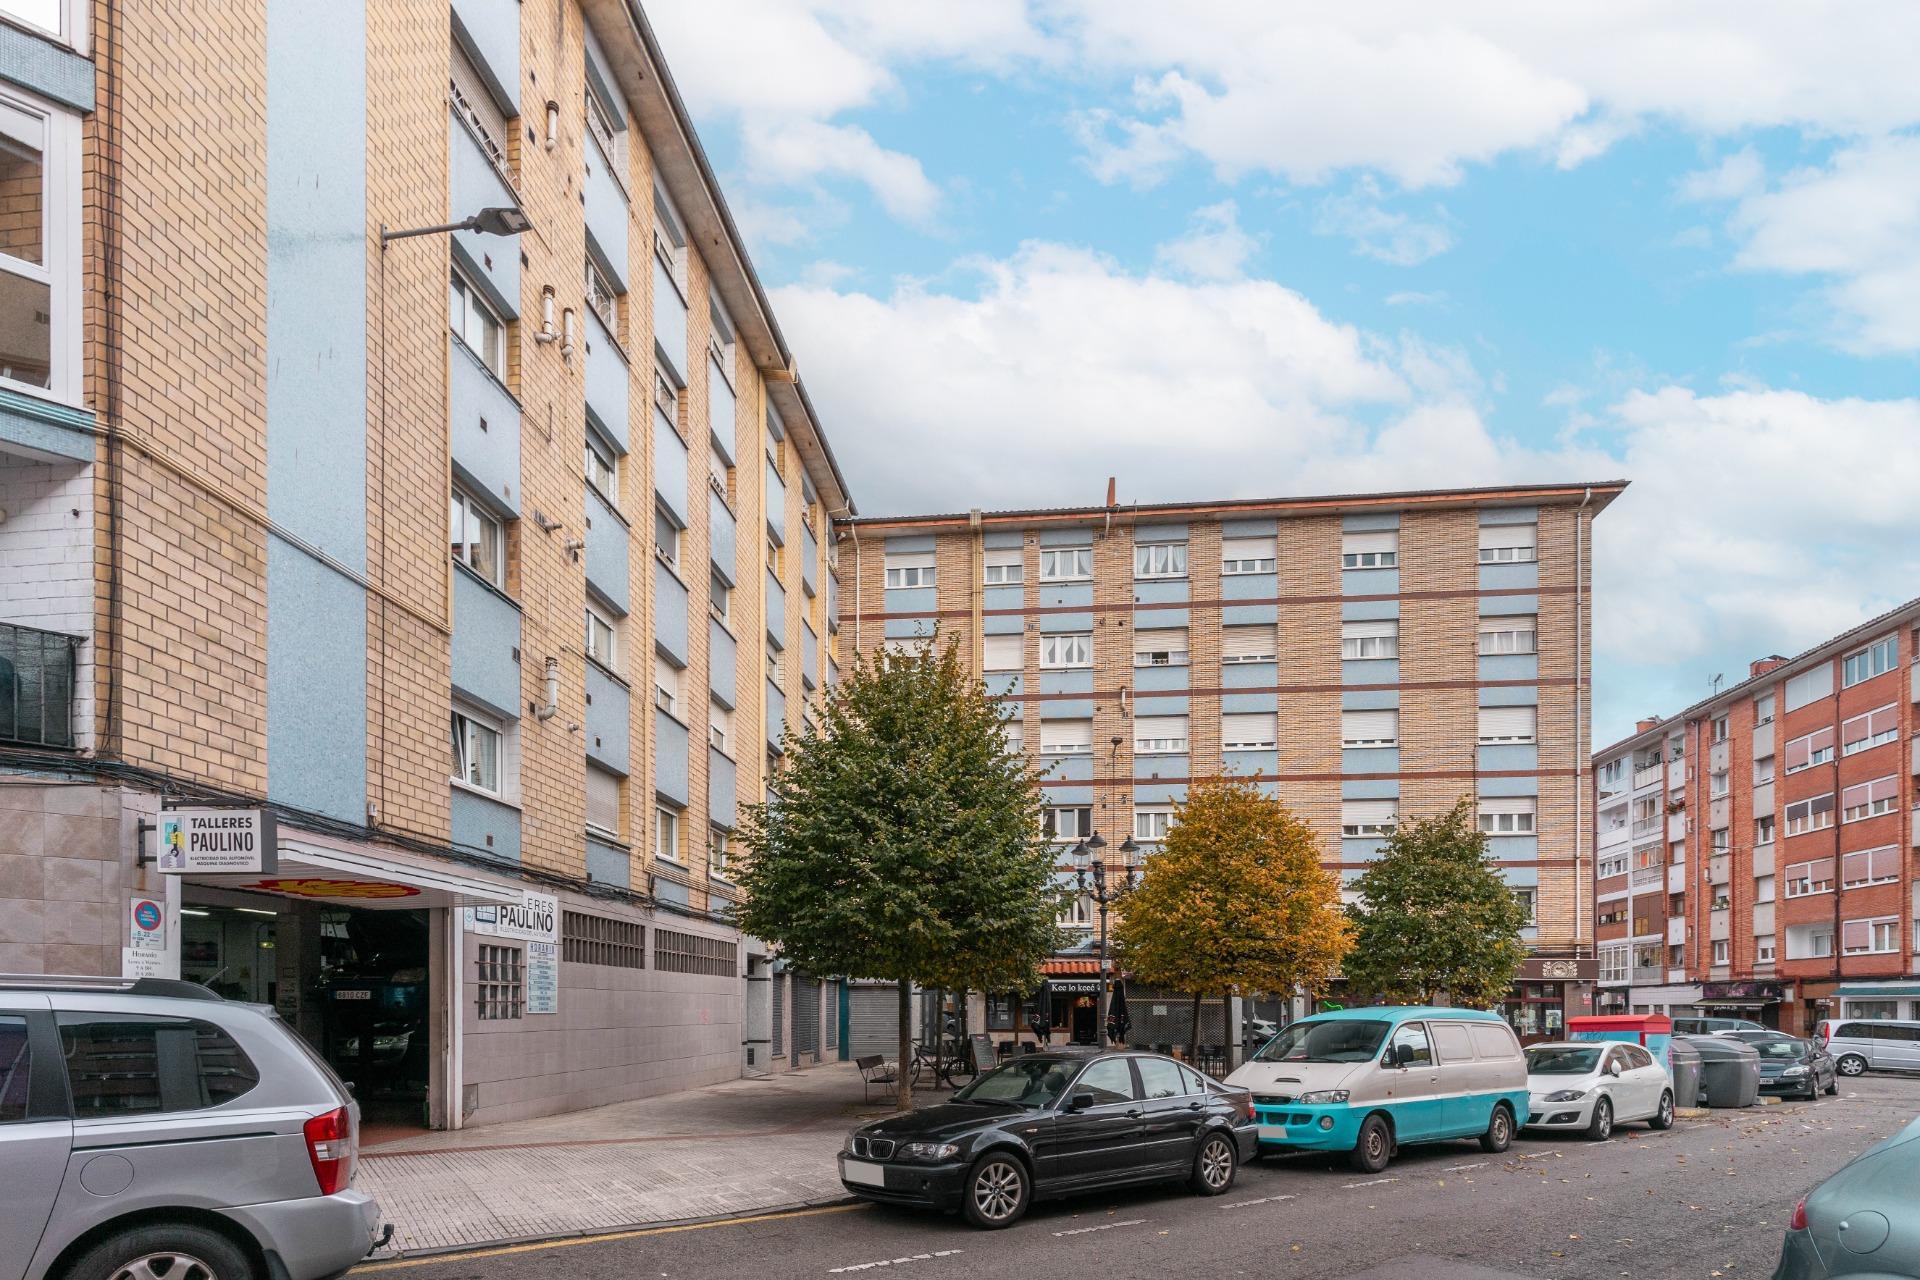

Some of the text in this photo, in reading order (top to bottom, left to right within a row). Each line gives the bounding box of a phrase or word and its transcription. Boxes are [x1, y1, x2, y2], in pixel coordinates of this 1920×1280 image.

[190, 817, 253, 829] TALLERES
[191, 831, 254, 852] PAULINO
[500, 905, 553, 933] PAULINO
[1068, 983, 1076, 992] lo
